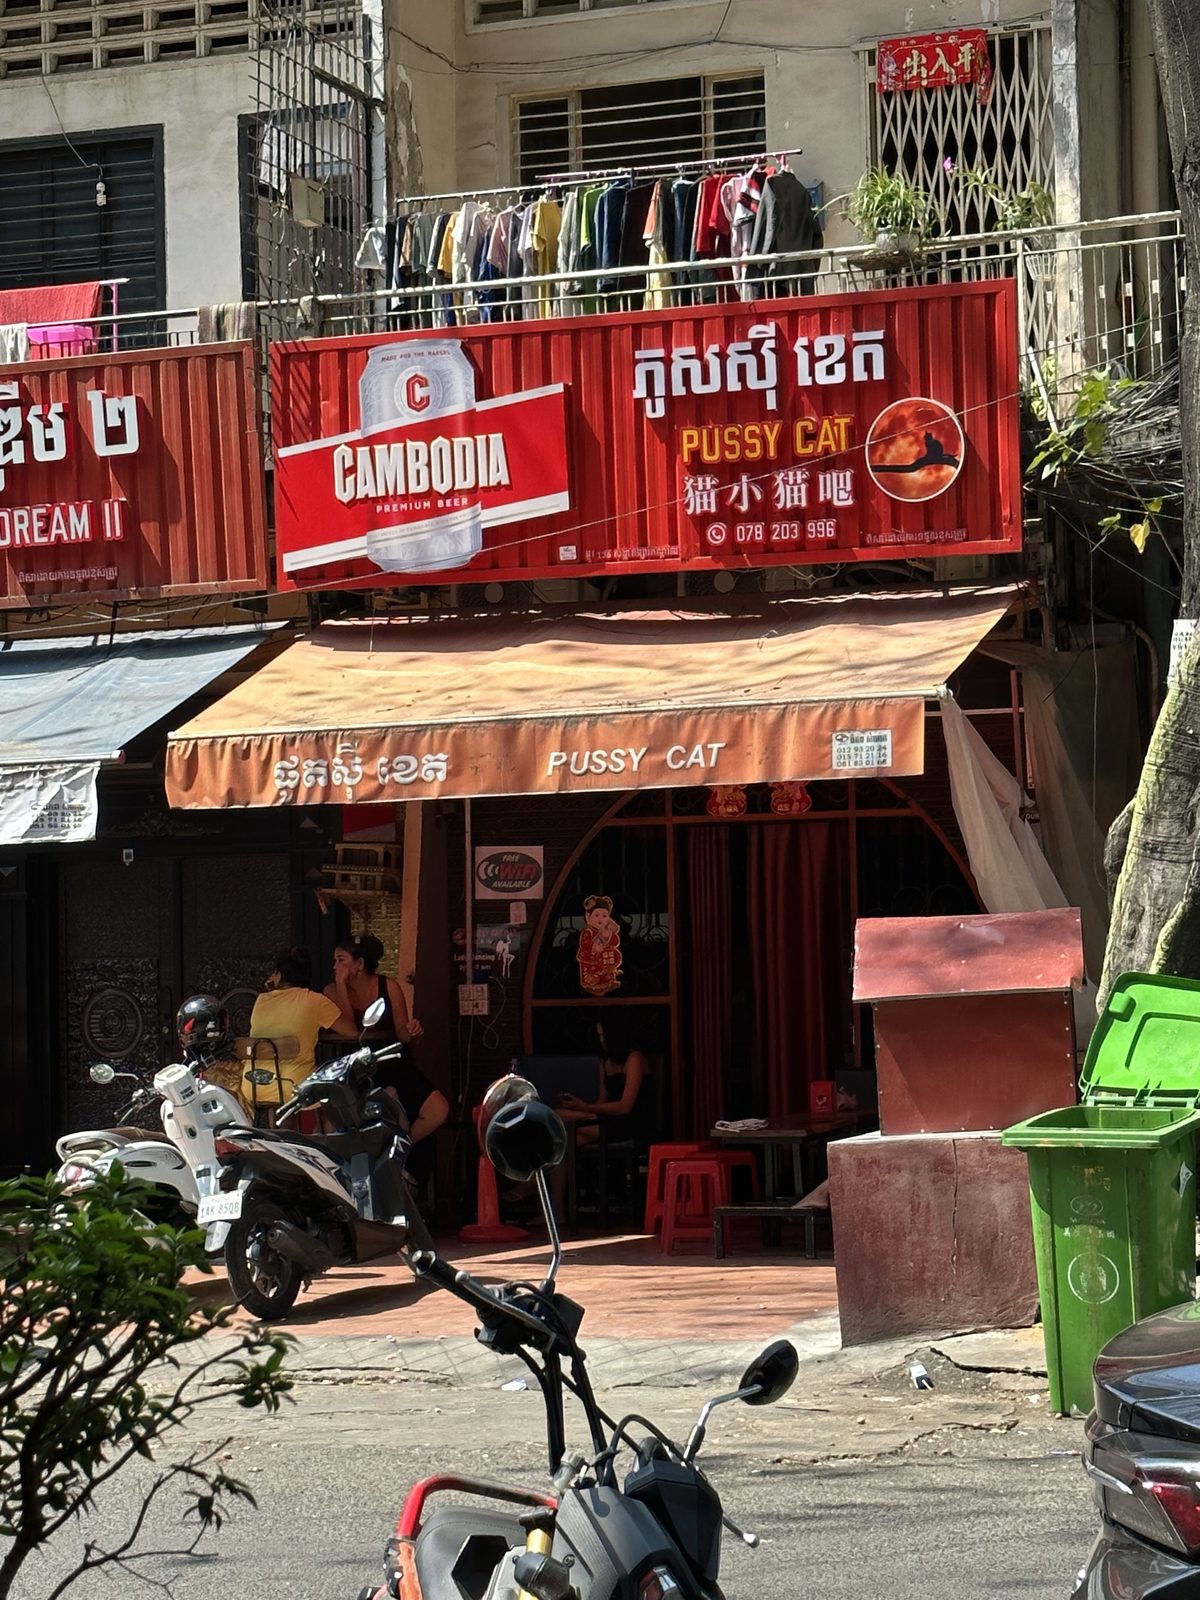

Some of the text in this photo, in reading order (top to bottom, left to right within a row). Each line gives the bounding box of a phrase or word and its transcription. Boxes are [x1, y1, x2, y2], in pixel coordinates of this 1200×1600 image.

[682, 417, 851, 463] PUSSY CAT
[333, 432, 511, 504] CAMBODIA
[376, 497, 469, 514] PREMIUM BEER
[736, 521, 834, 542] 078 203 996
[546, 742, 727, 776] PUSSY CAT
[836, 746, 852, 754] 012
[502, 854, 520, 864] FREE
[491, 880, 532, 889] AVAILABLE
